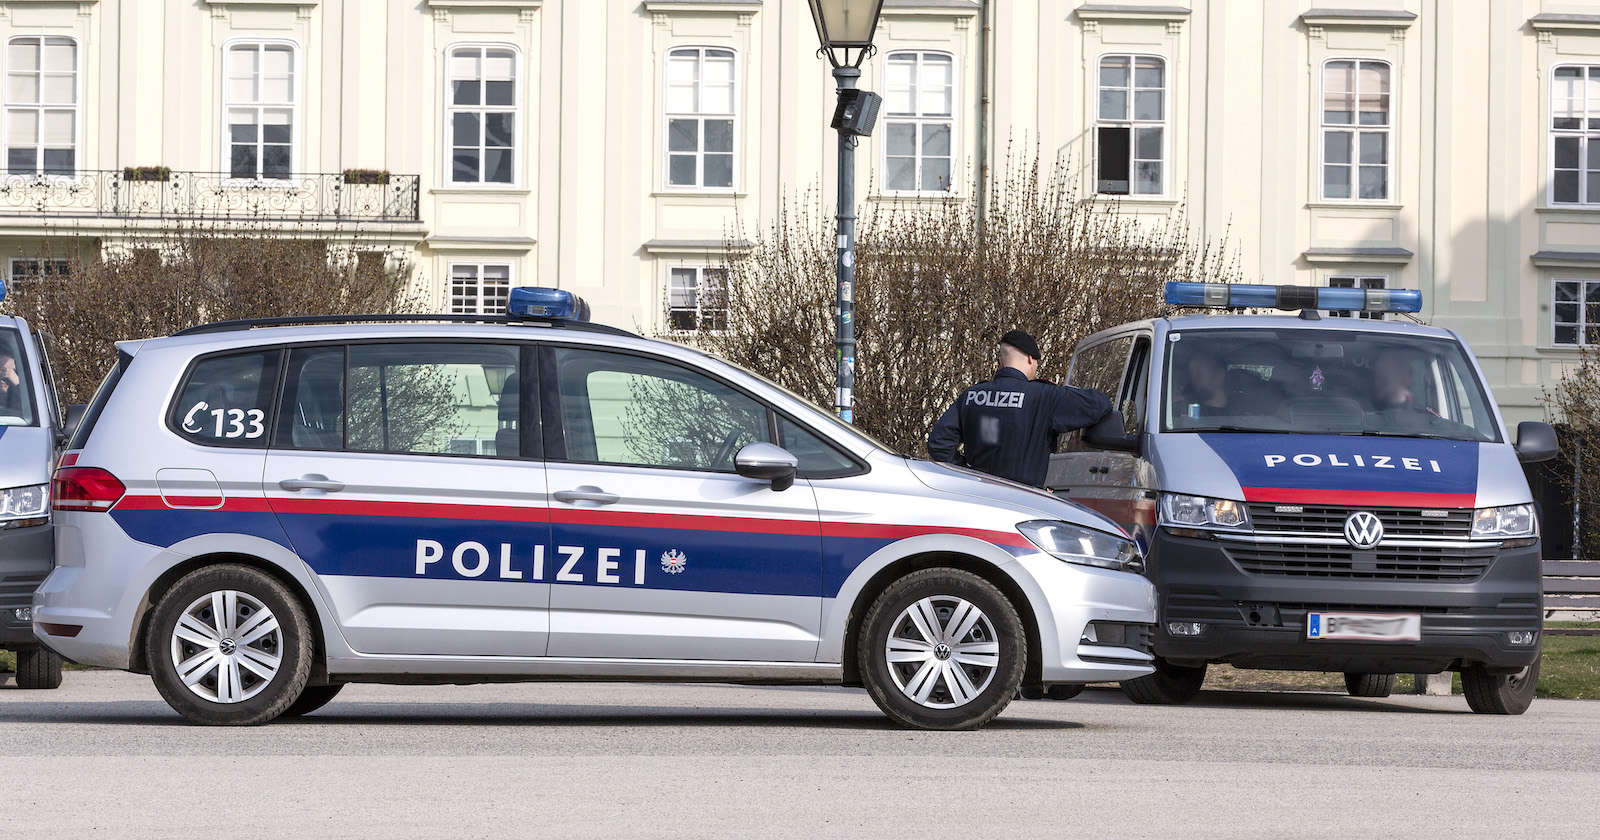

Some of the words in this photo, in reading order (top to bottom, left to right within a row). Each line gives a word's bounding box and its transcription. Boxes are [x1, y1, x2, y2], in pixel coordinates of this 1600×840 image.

[965, 390, 1025, 408] POLIZEI
[211, 408, 265, 439] 133
[1263, 454, 1442, 473] POLIZEI
[415, 539, 646, 584] POLIZEI
